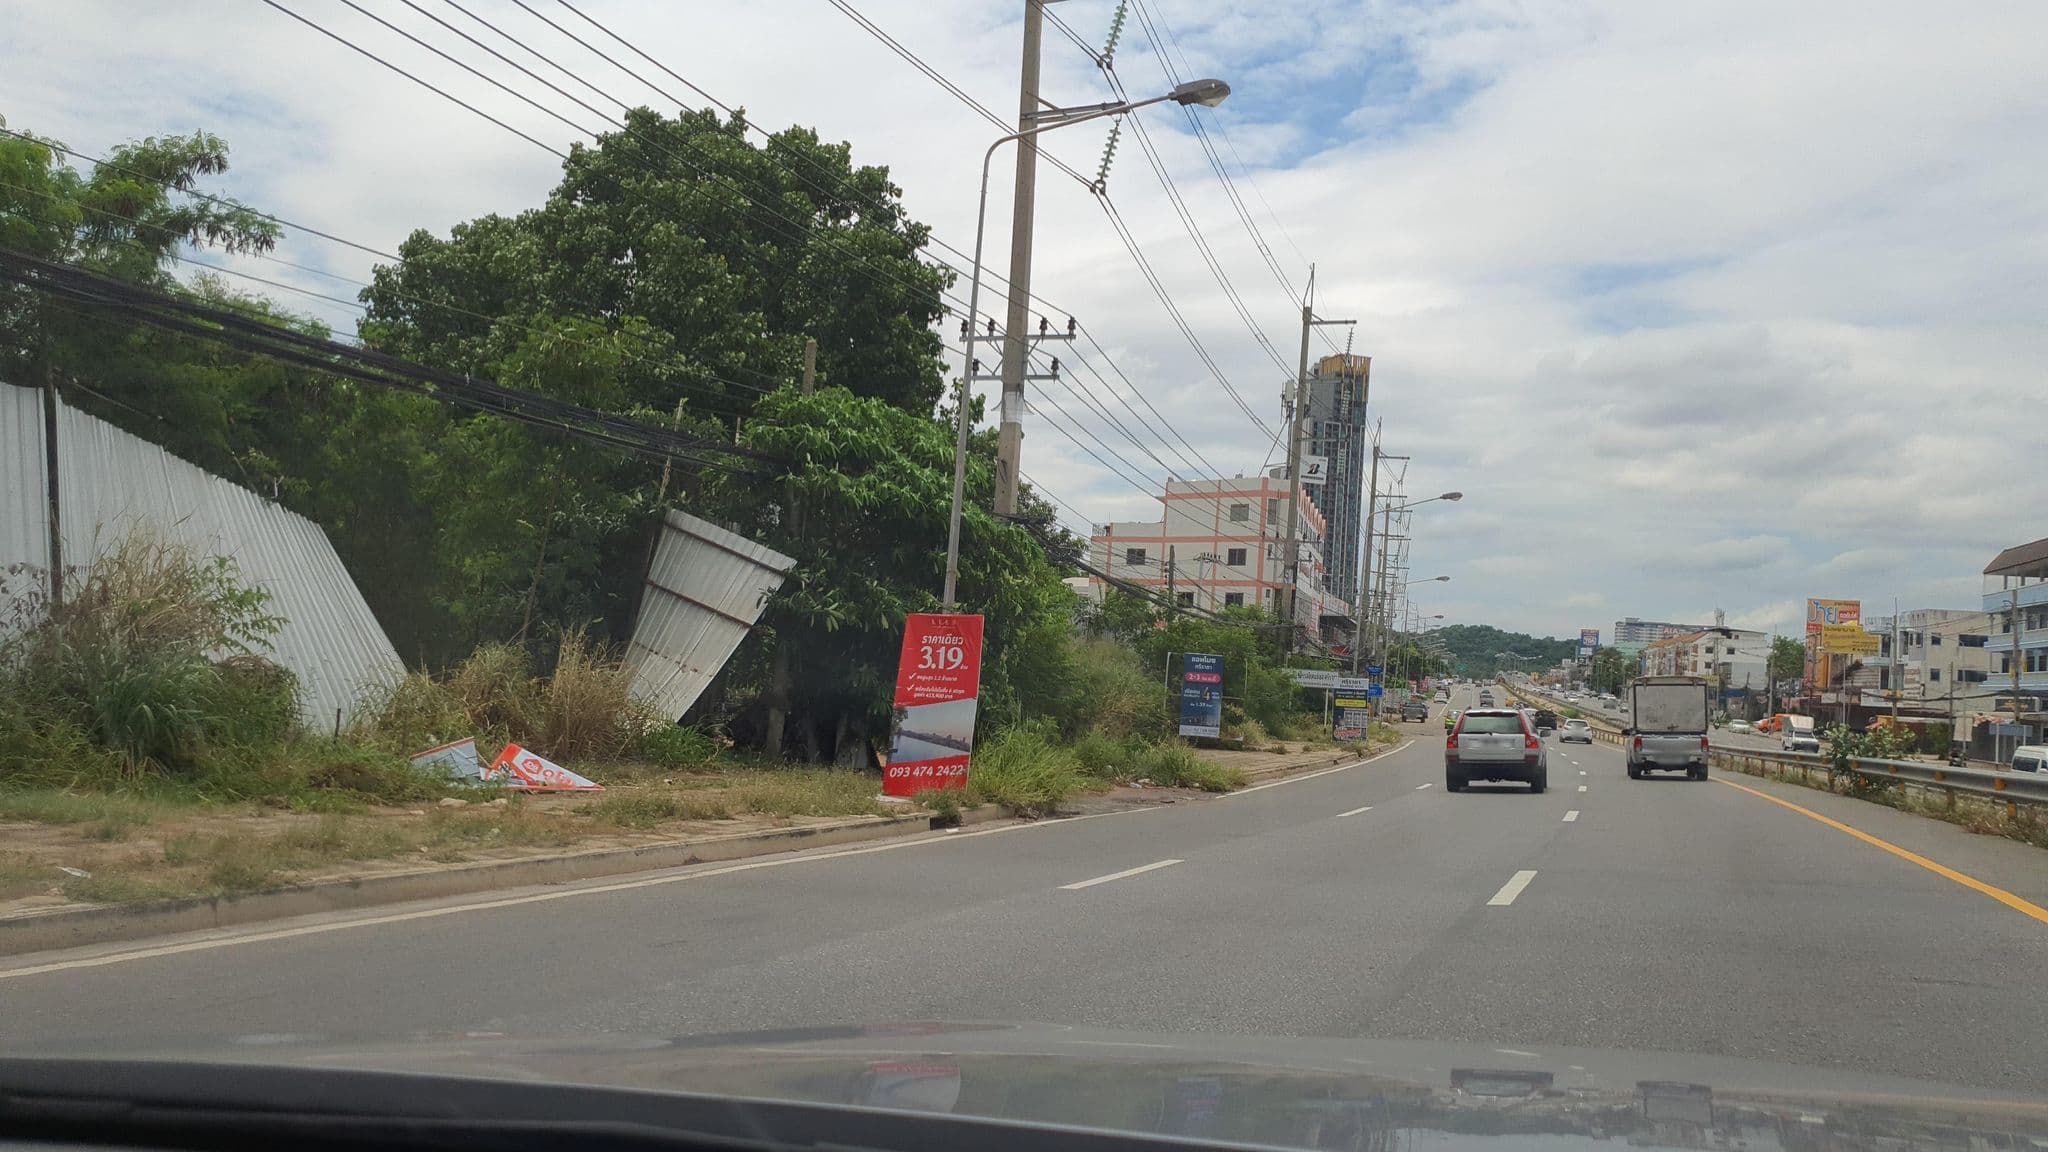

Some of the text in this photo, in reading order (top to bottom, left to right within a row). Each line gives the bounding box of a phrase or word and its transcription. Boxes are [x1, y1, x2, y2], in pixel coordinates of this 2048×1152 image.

[921, 633, 964, 645] ราคาเดียว
[918, 645, 963, 670] 3.19
[889, 766, 911, 778] 093
[913, 766, 933, 777] 474
